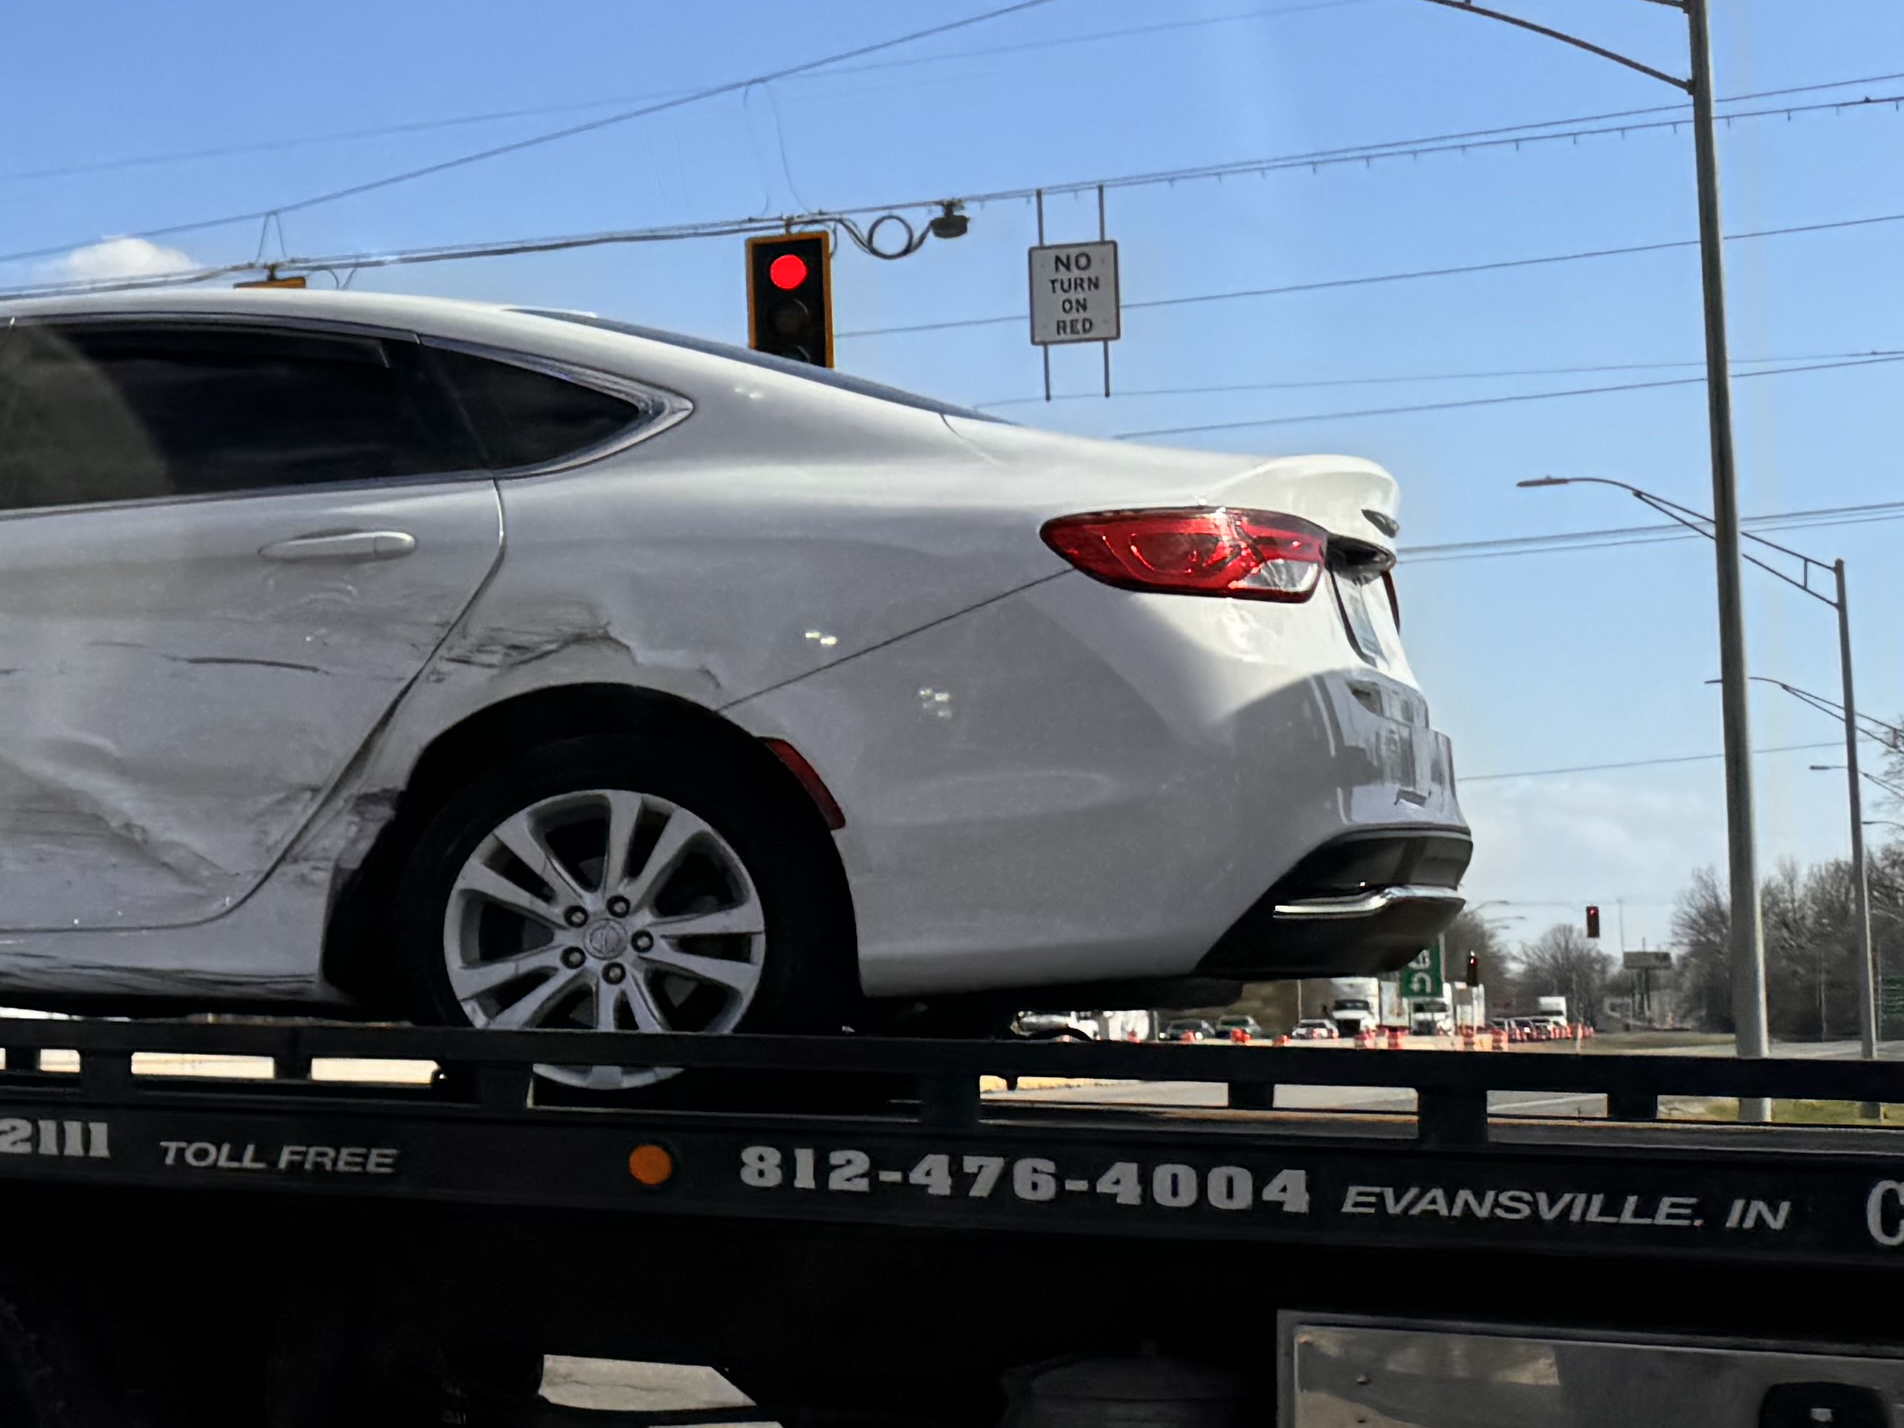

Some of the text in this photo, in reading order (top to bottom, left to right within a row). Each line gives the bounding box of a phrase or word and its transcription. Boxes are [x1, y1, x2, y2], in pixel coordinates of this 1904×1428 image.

[1054, 252, 1092, 272] NO
[1049, 275, 1100, 294] TURN
[1061, 297, 1088, 314] ON
[1056, 317, 1093, 336] RED
[159, 1140, 401, 1174] TOLL FREE
[739, 1145, 1311, 1214] 812-476-4004
[1724, 1198, 1792, 1231] IN
